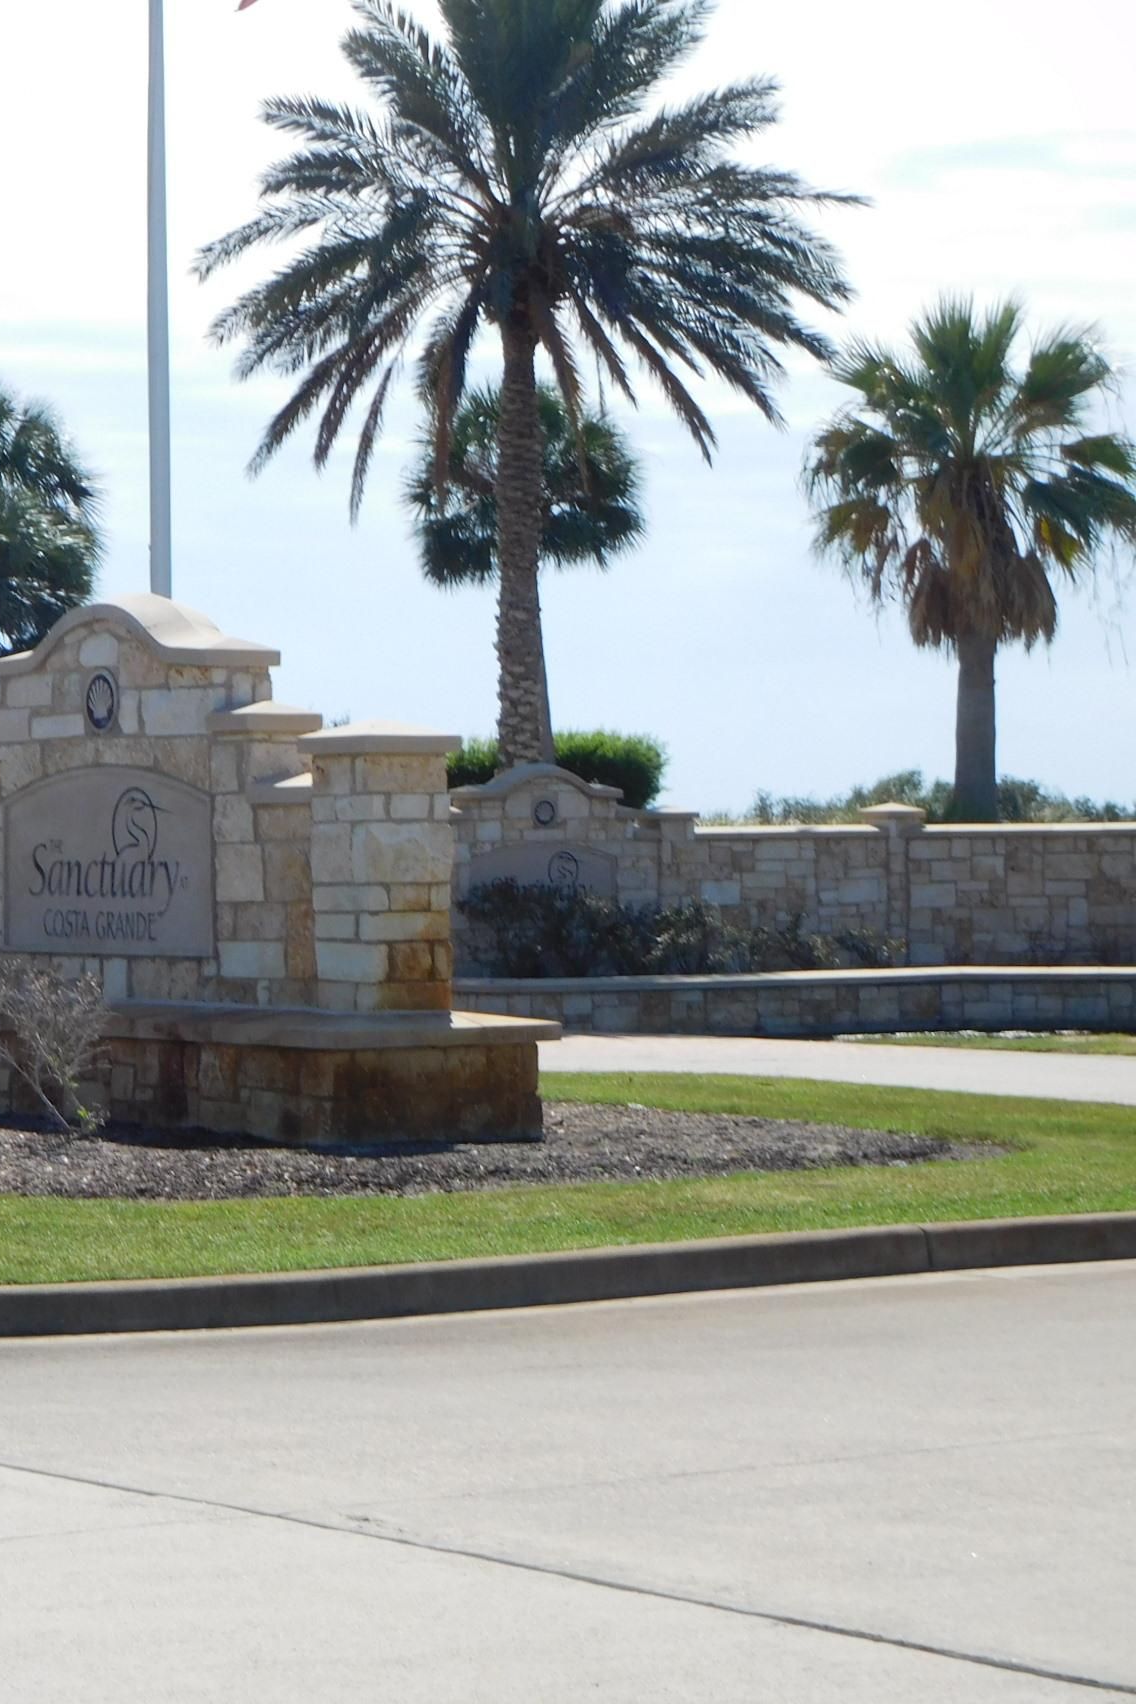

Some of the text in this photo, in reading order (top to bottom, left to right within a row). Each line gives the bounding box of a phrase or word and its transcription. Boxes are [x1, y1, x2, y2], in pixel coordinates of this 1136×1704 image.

[28, 843, 180, 918] Sanctuary
[43, 908, 157, 942] COSTA GRANDE
